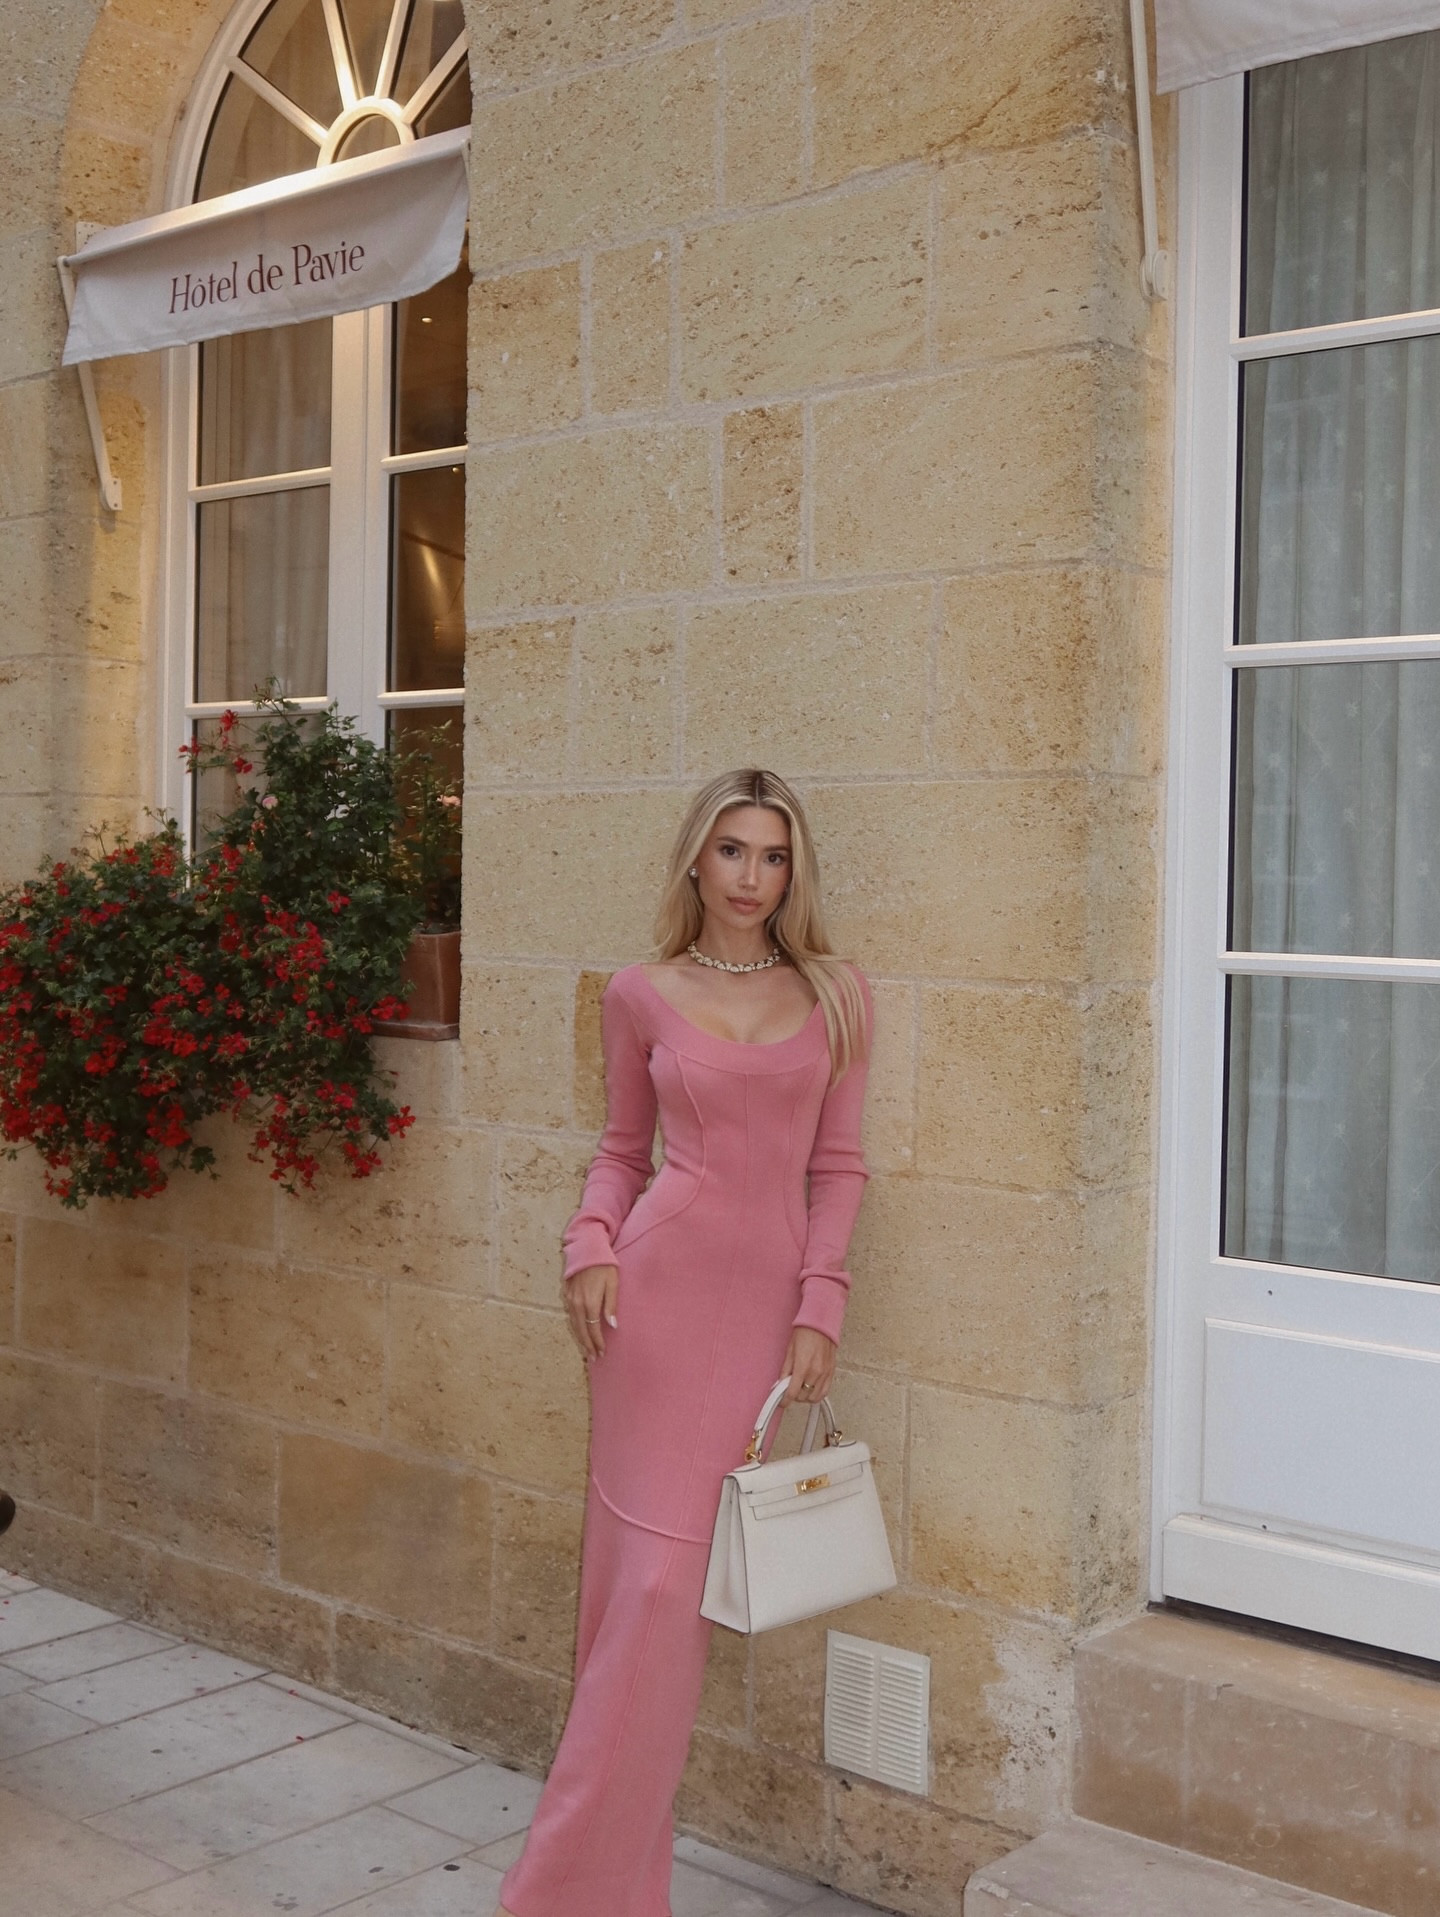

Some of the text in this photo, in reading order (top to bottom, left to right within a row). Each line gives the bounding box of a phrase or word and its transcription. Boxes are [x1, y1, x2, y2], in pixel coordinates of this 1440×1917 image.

[169, 241, 365, 314] Hôtel de Pavie
